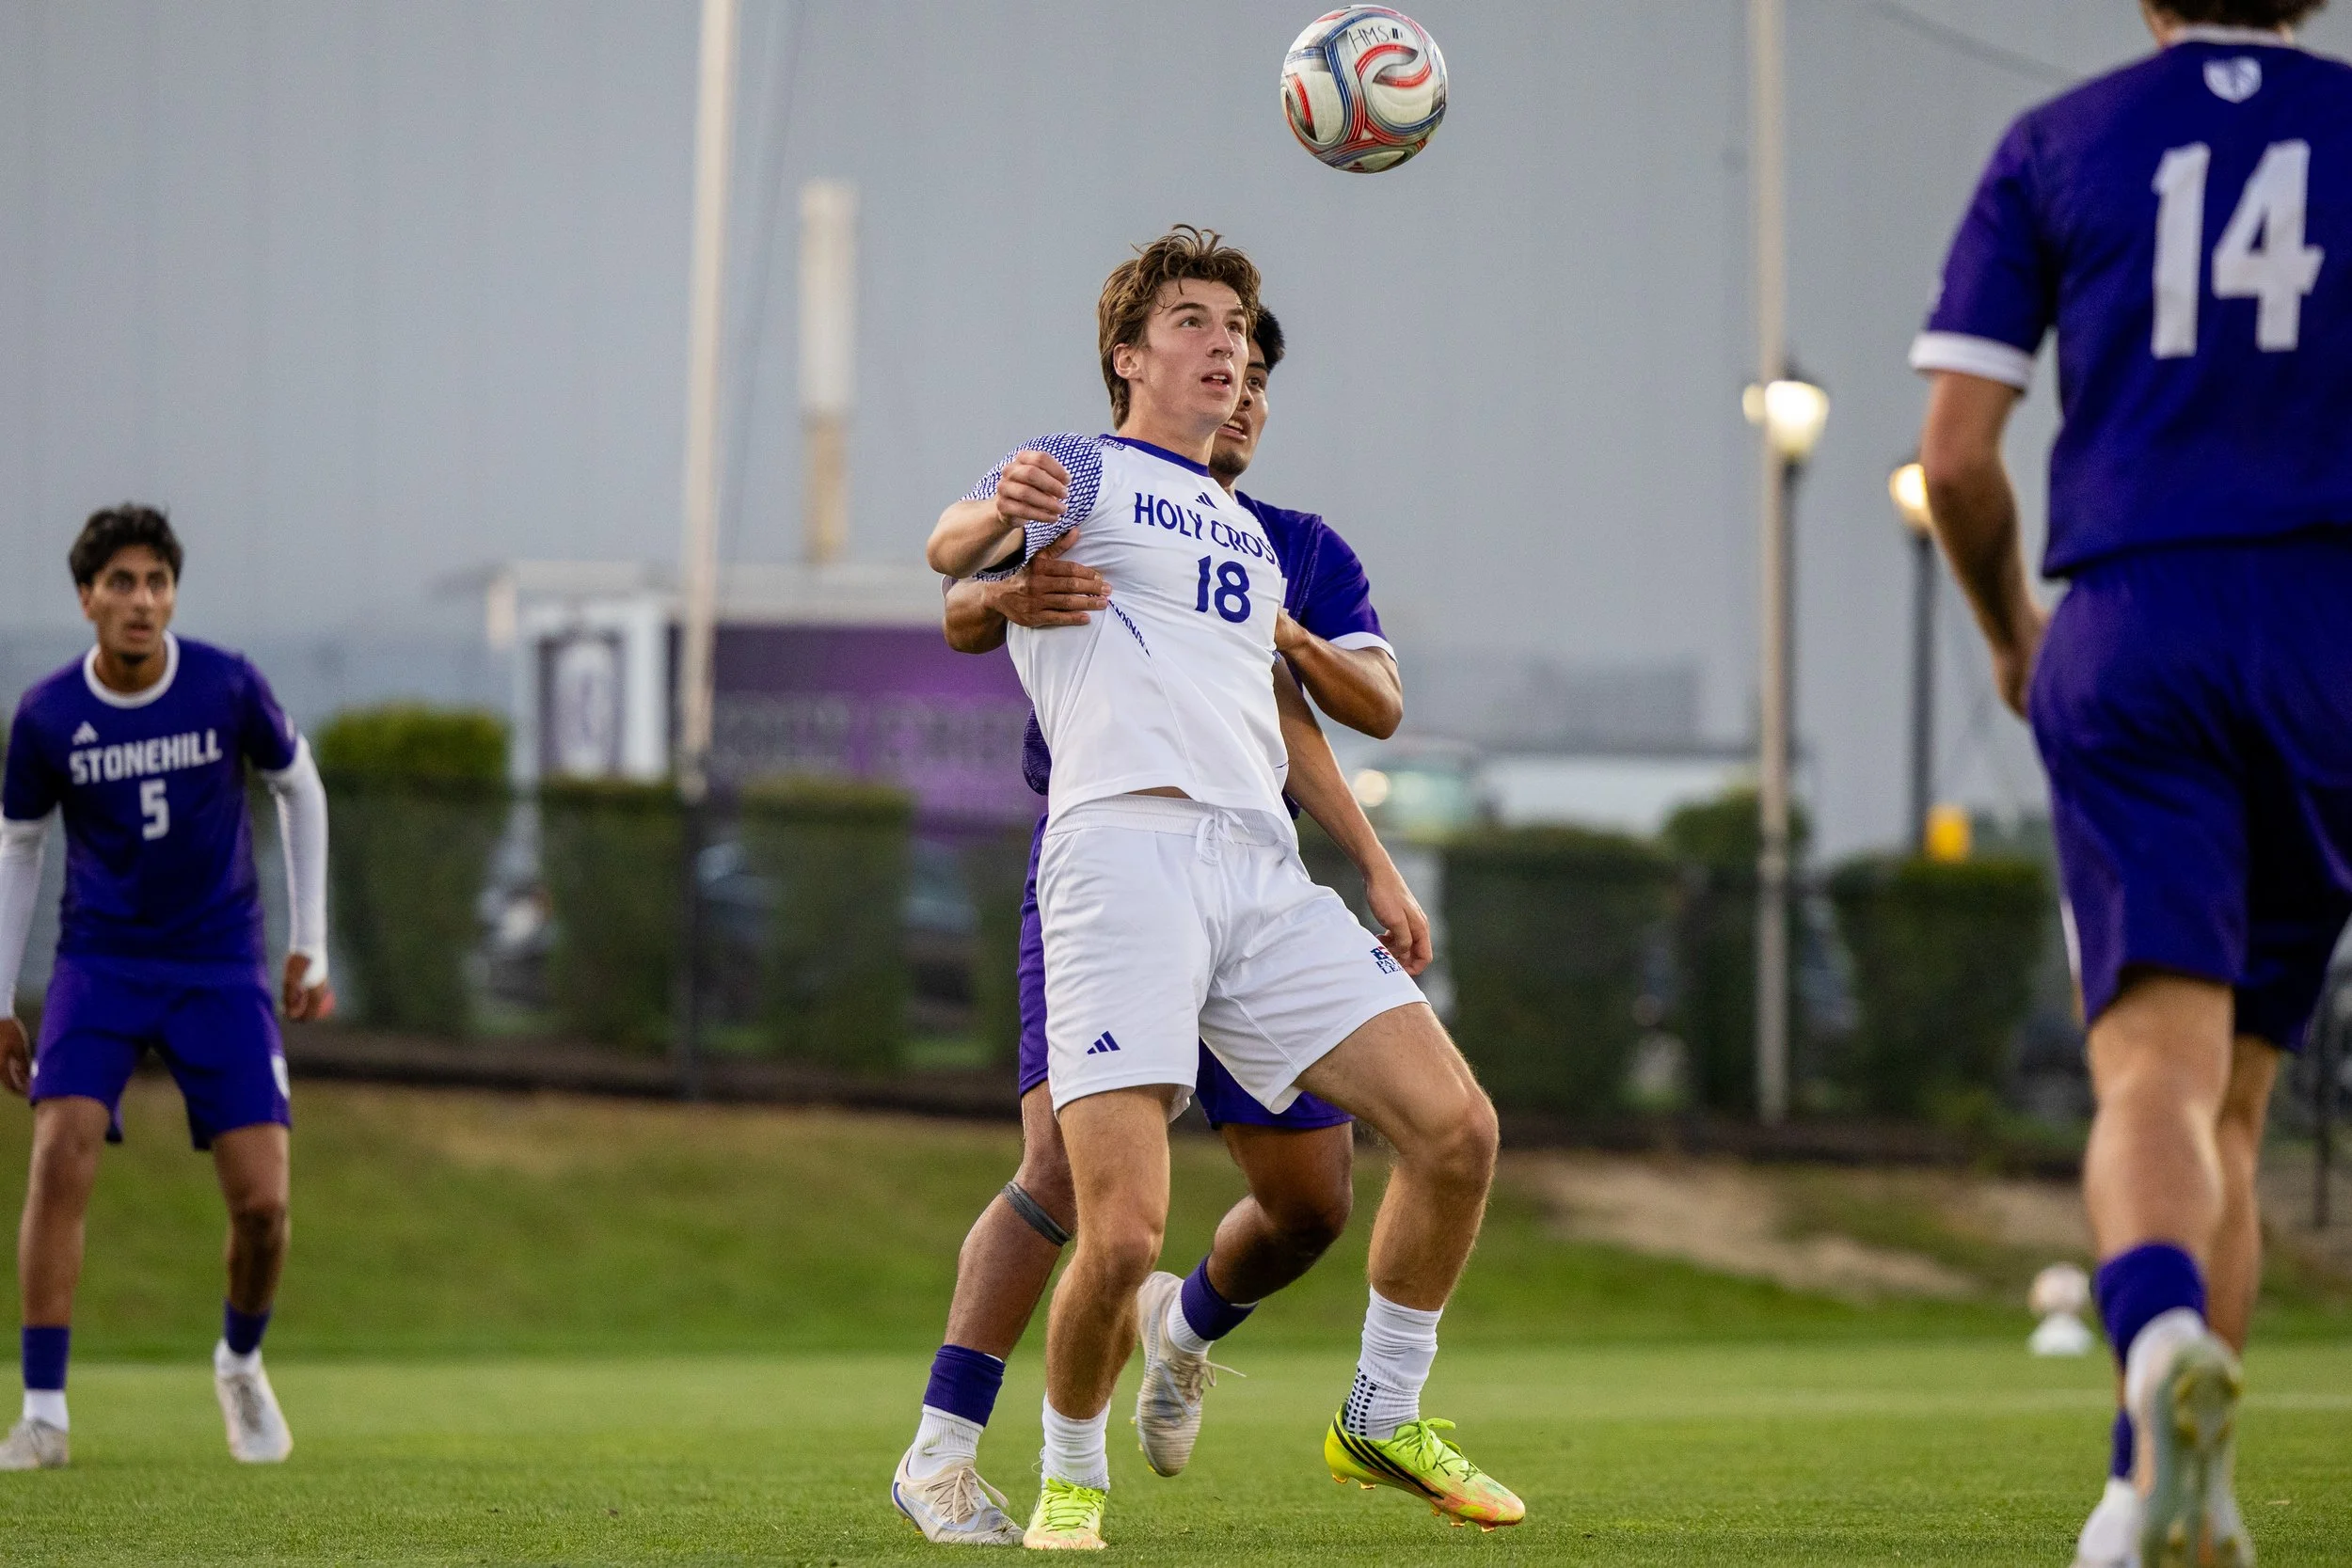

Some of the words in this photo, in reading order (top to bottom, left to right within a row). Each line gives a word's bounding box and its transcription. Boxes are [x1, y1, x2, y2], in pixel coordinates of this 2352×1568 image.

[2152, 139, 2324, 358] 14
[1134, 492, 1202, 540] HOLY
[1211, 520, 1280, 568] CROS
[1195, 555, 1251, 623] 18
[69, 728, 223, 784] STONEHILL
[139, 778, 170, 841] 5
